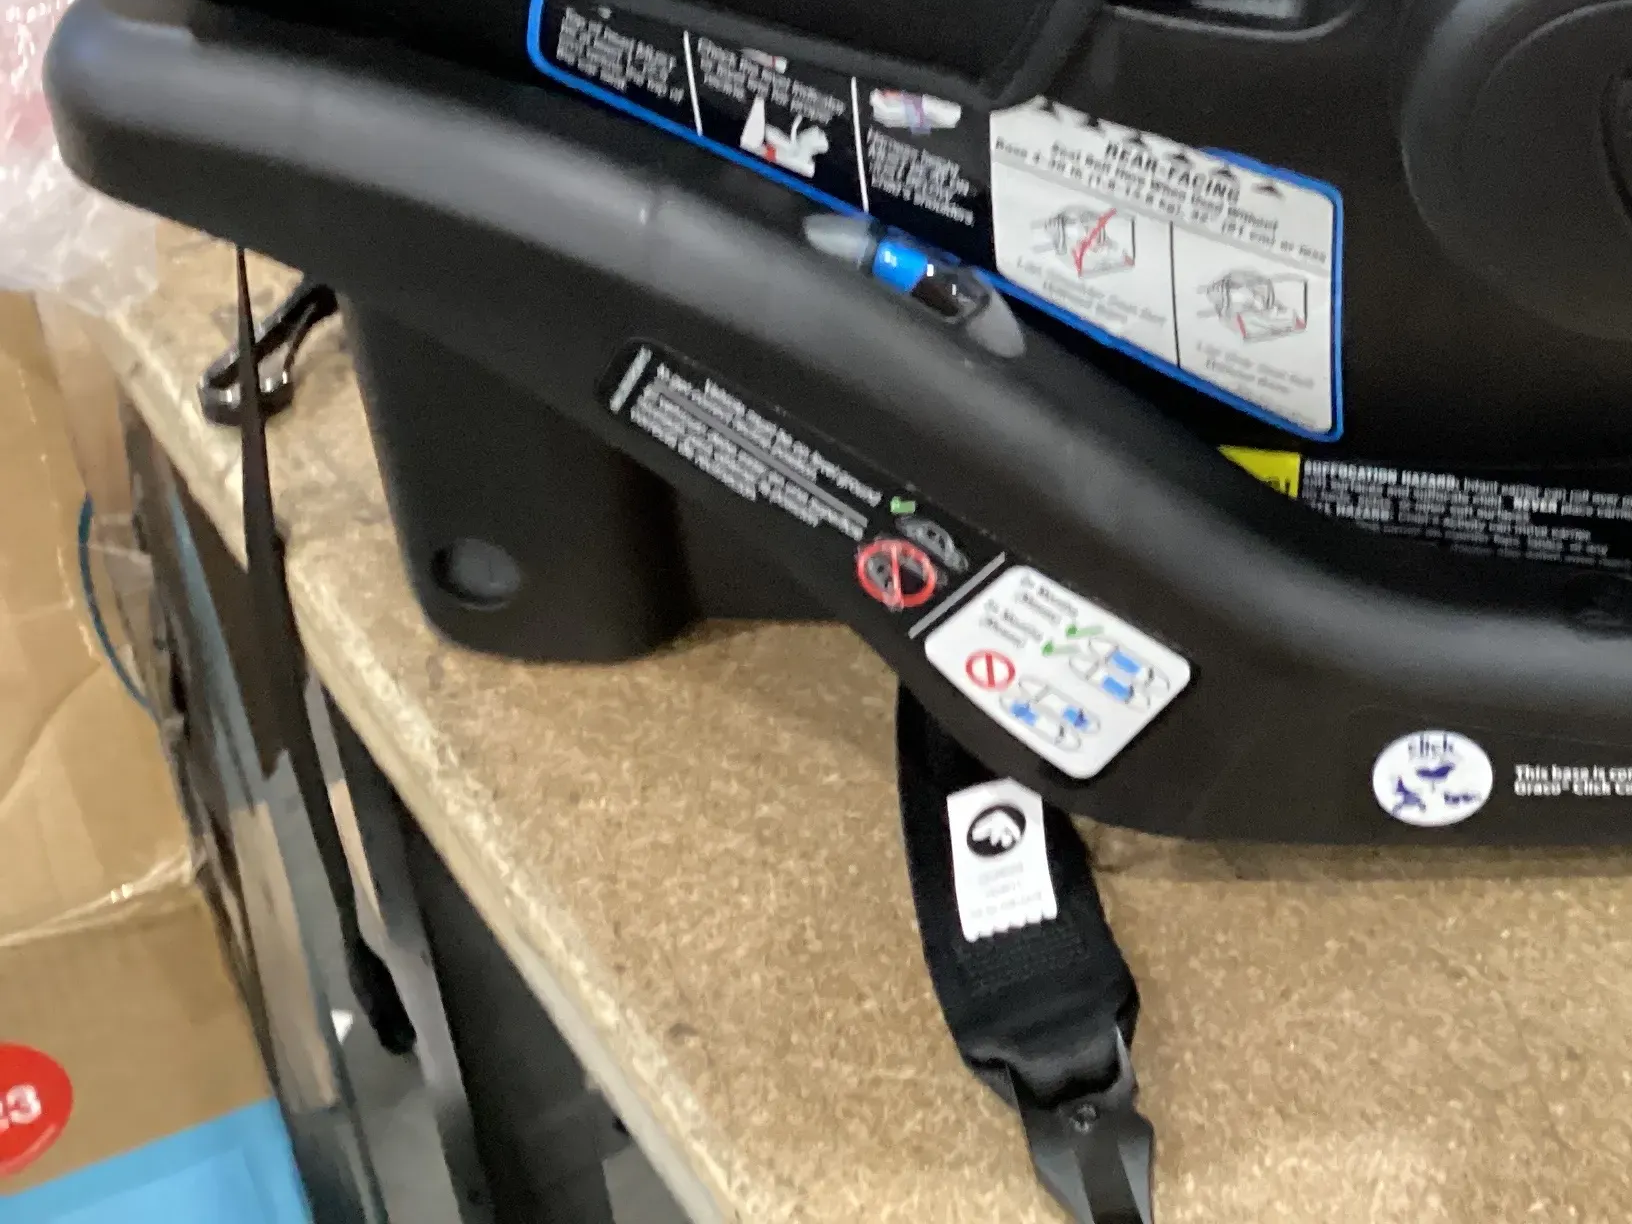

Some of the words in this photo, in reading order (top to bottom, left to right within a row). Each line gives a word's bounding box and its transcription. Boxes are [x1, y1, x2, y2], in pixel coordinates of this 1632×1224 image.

[1515, 763, 1549, 781] This
[1551, 763, 1590, 781] base
[1593, 764, 1607, 781] is
